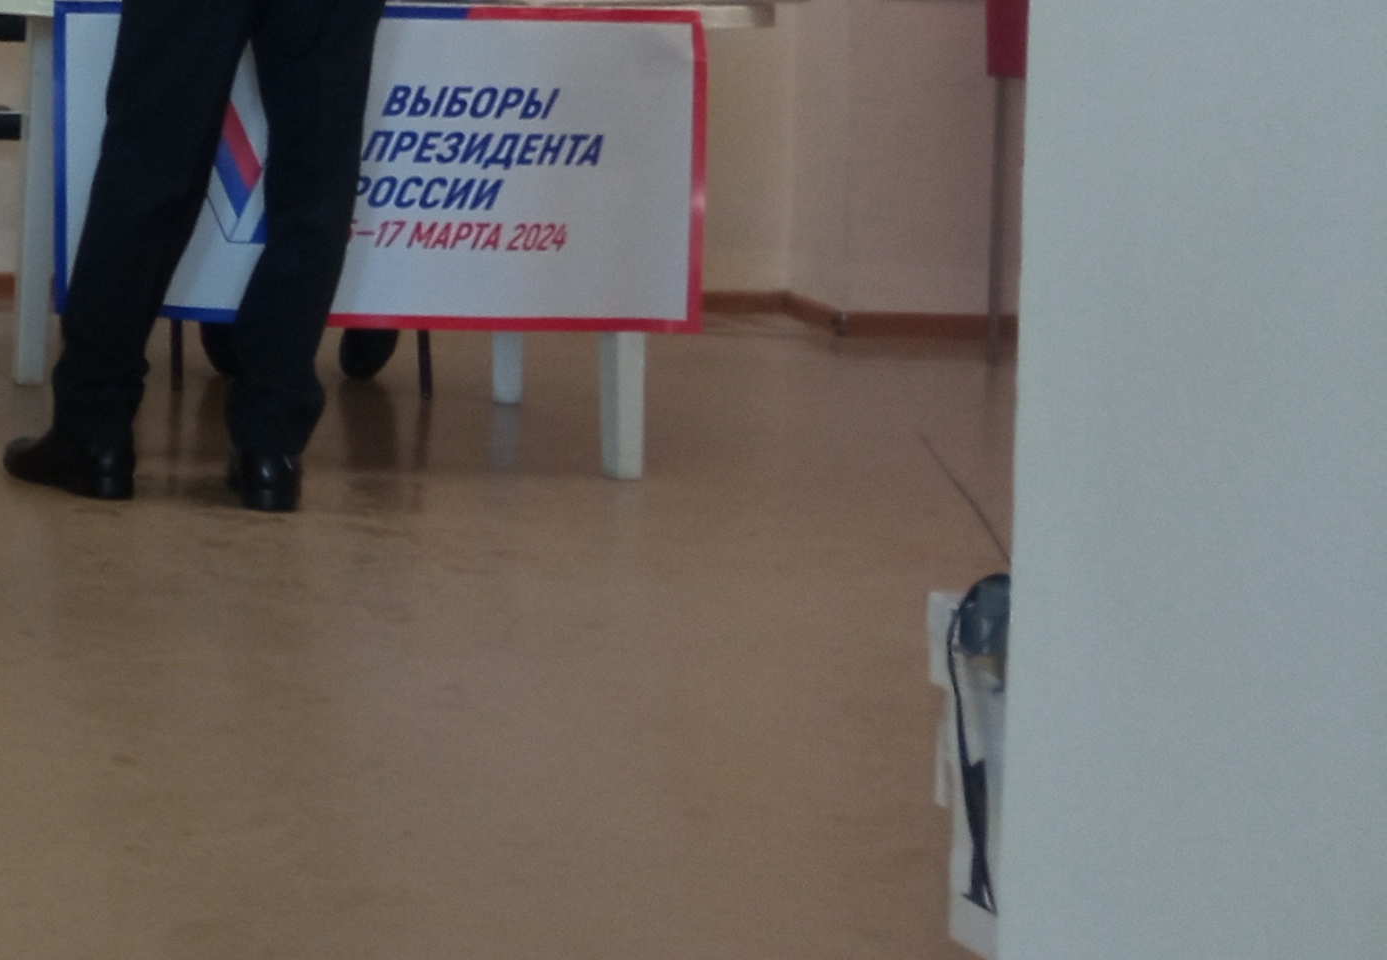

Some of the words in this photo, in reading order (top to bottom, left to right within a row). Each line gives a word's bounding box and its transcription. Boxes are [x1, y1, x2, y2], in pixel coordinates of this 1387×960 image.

[382, 85, 561, 120] ВЫБОРЫ
[361, 129, 605, 171] ПРЕЗИДЕНТА
[406, 221, 503, 251] МАРТА
[506, 222, 569, 252] 2024
